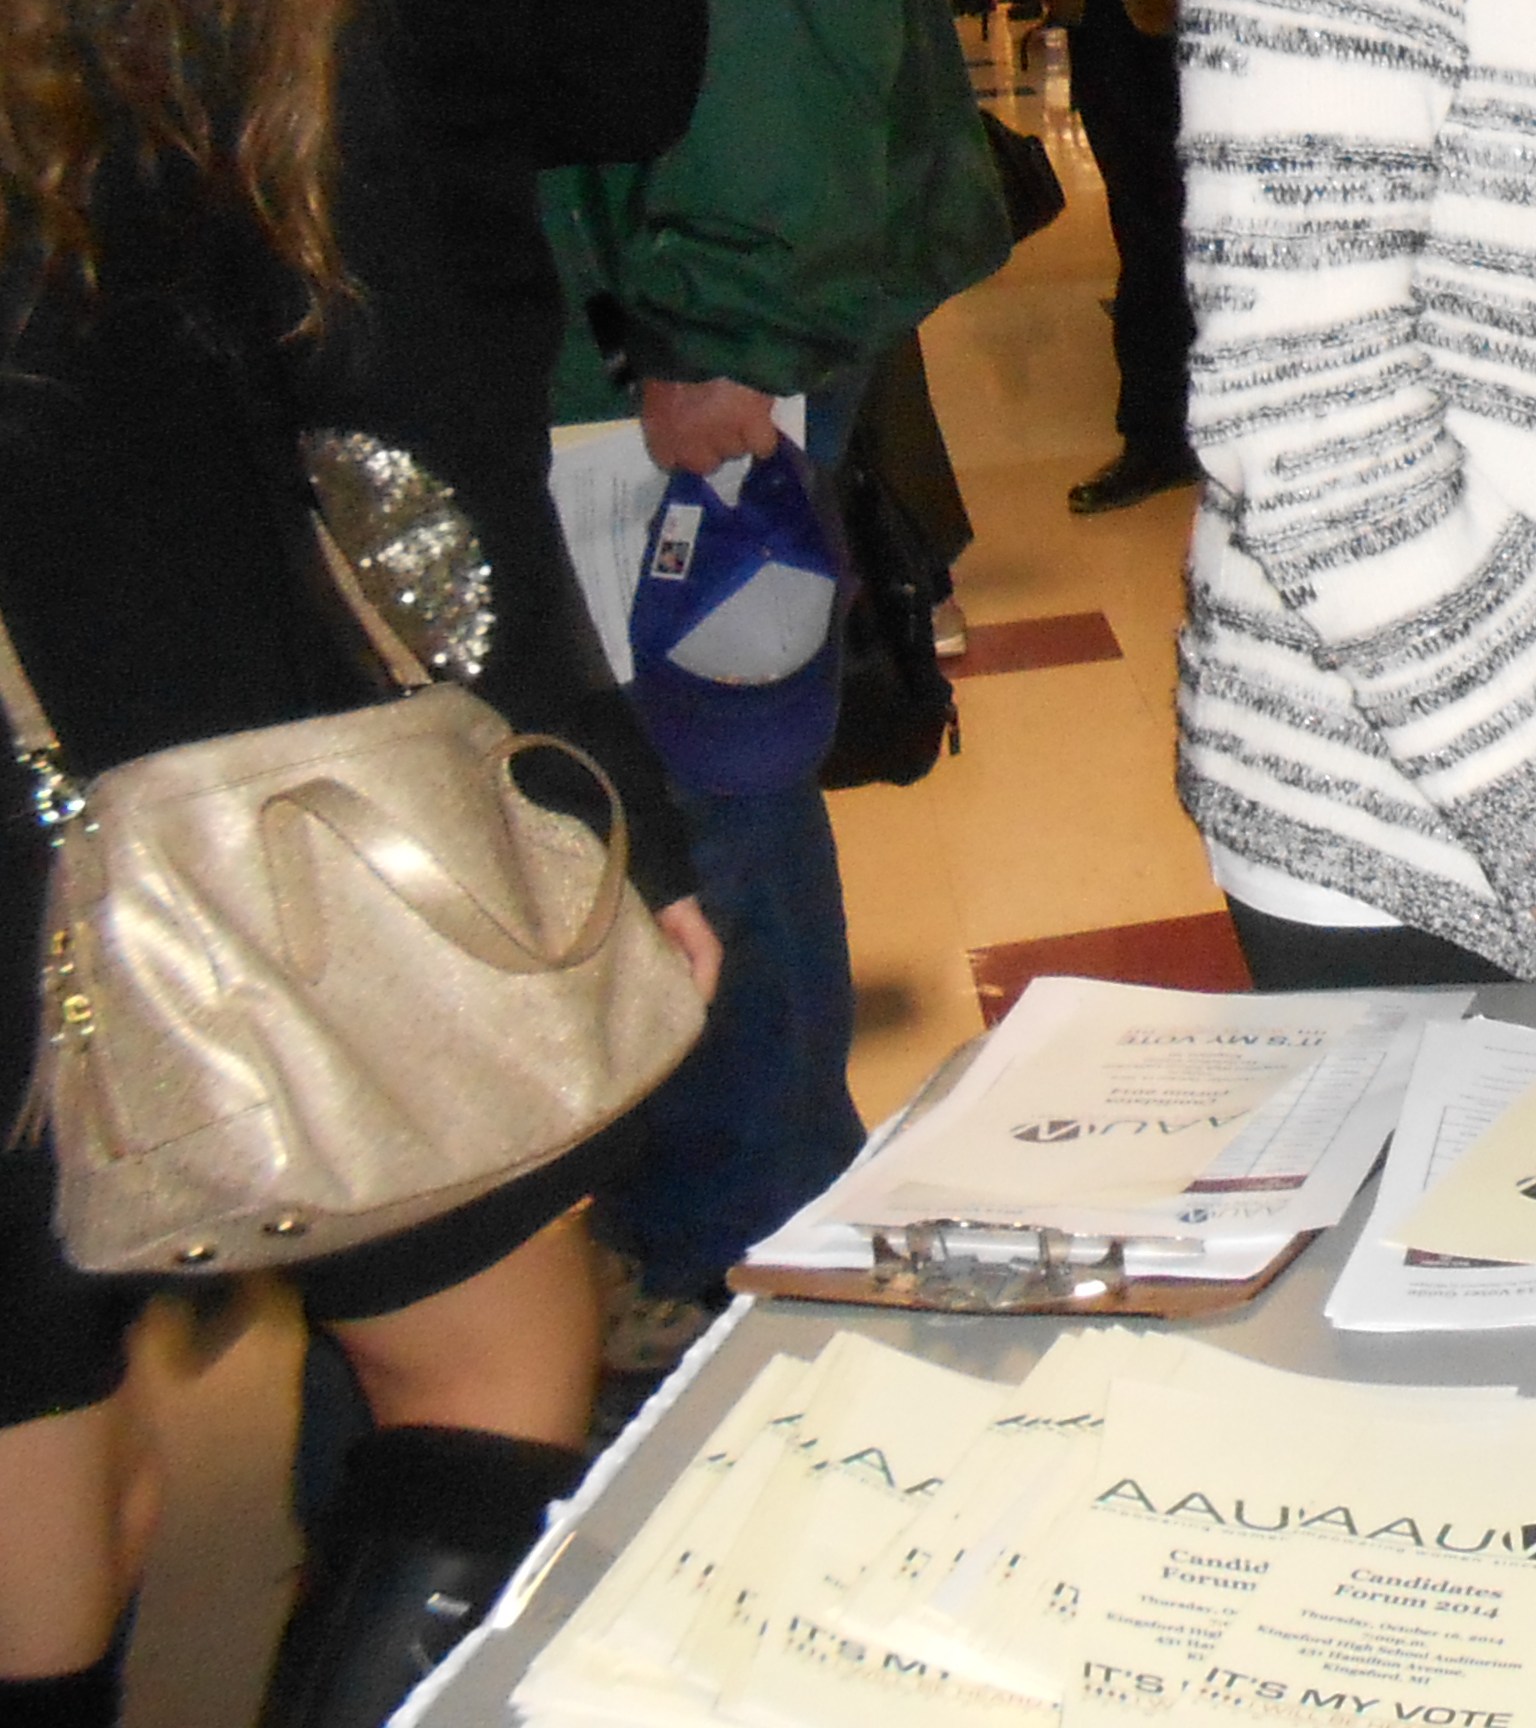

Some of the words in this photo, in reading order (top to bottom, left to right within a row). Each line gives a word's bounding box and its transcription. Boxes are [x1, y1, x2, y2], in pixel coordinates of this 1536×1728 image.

[1206, 1034, 1259, 1046] MY
[1095, 1478, 1305, 1532] AAU
[1350, 1567, 1503, 1600] Candidates
[1333, 1583, 1427, 1609] Forum
[1434, 1600, 1499, 1620] 2014
[1299, 1608, 1373, 1629] Thursday,
[1379, 1621, 1439, 1638] October
[1256, 1624, 1334, 1647] Kingsford
[1336, 1637, 1373, 1654] High
[1377, 1644, 1429, 1661] School
[1433, 1653, 1523, 1670] Auditorium
[1328, 1650, 1402, 1669] Hamilton
[1083, 1661, 1165, 1694] IT'S
[1206, 1666, 1288, 1700] IT'S
[1300, 1689, 1380, 1714] MY
[1393, 1702, 1515, 1728] VOTE
